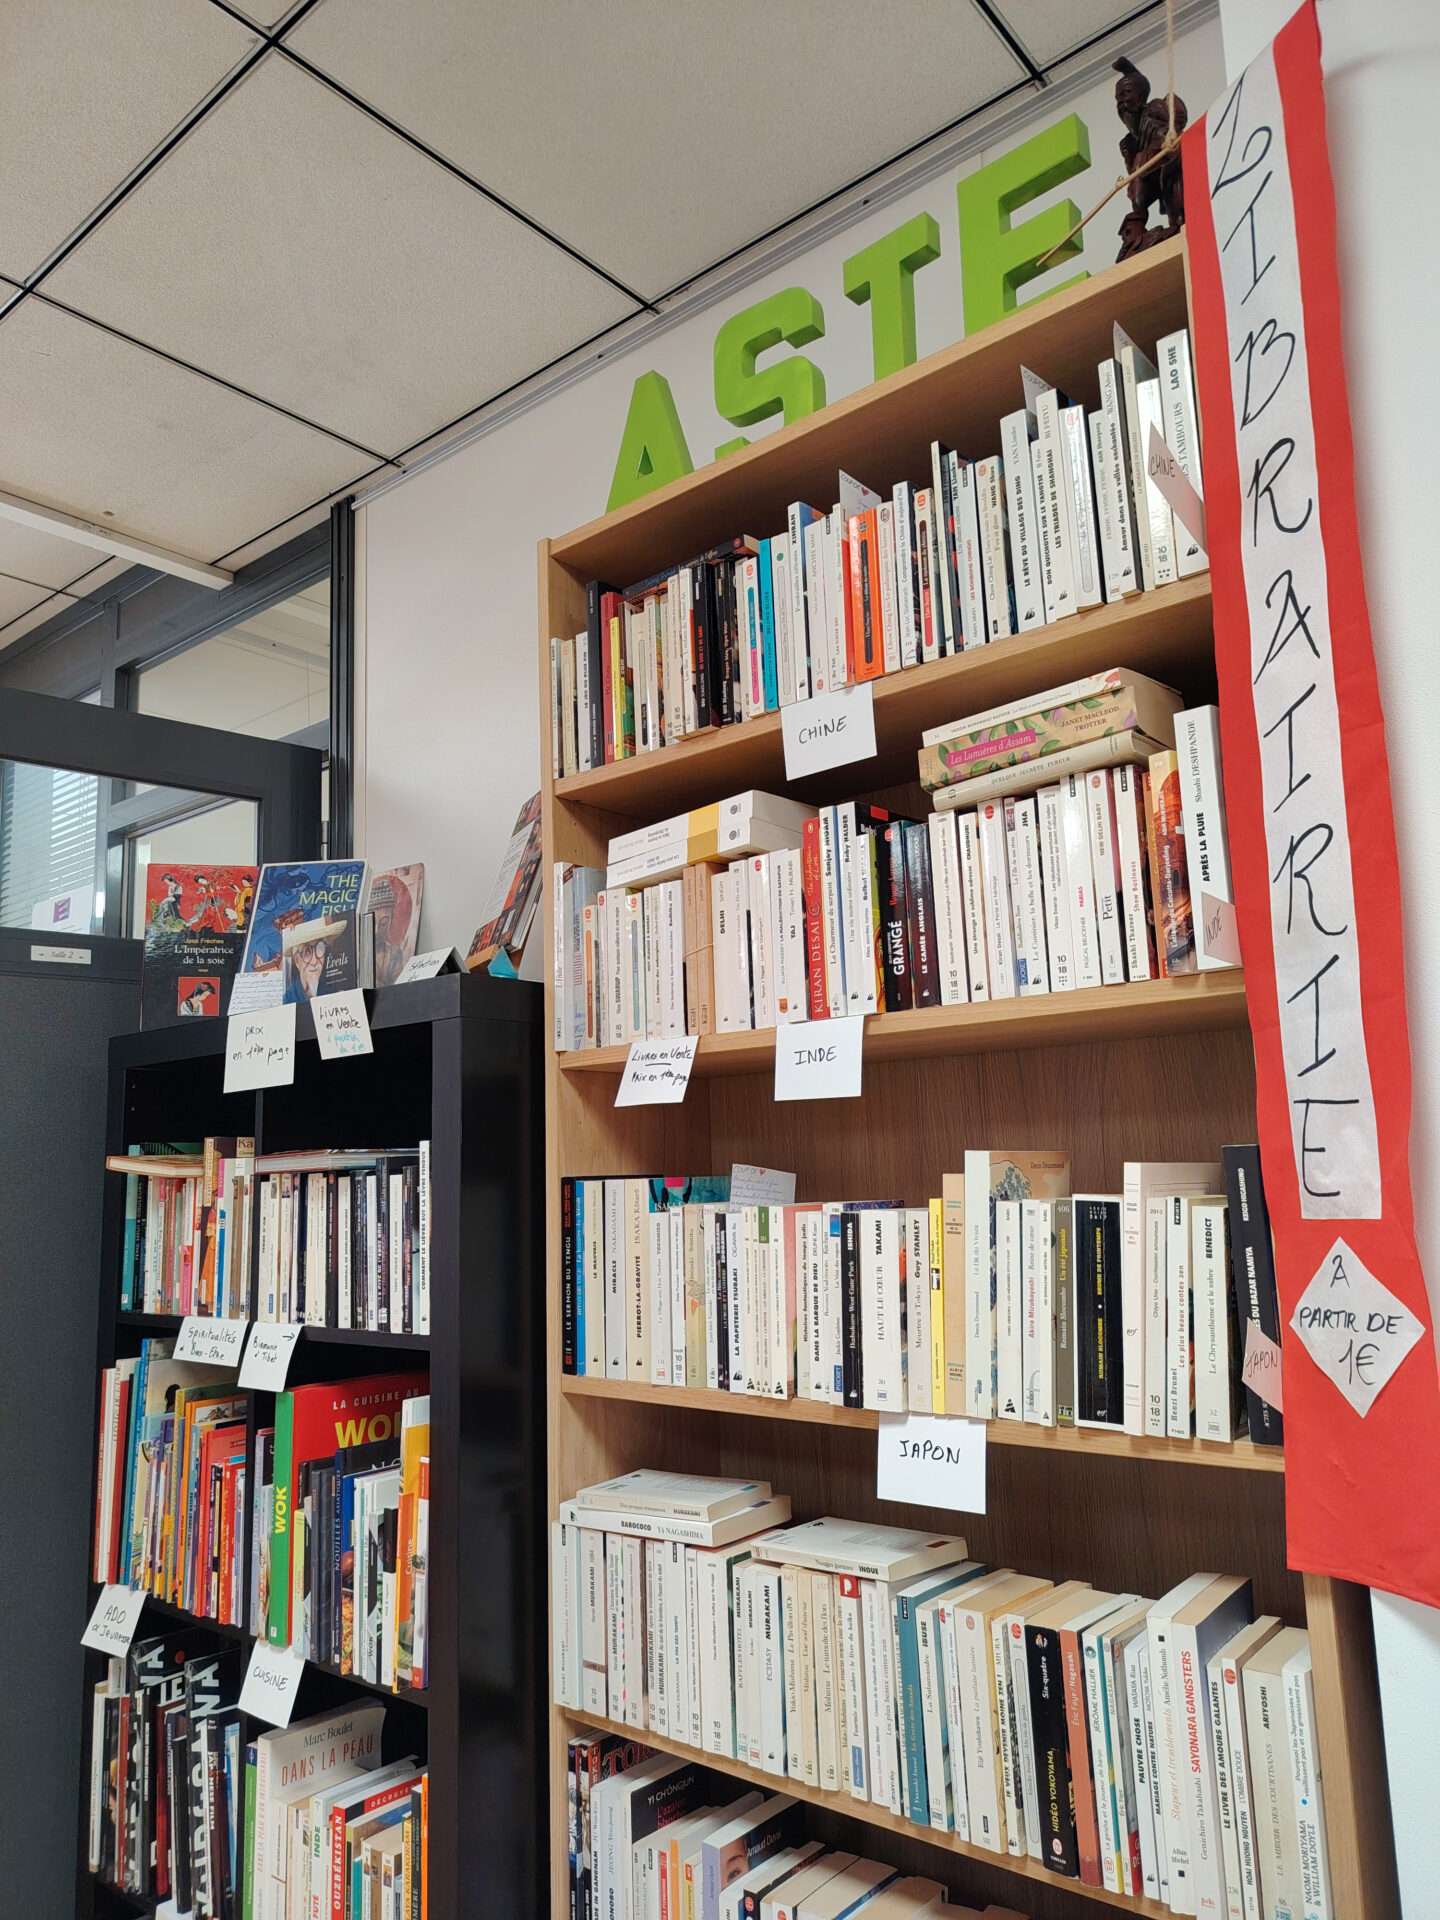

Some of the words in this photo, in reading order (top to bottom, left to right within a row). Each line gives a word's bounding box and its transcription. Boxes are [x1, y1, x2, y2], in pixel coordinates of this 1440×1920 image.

[604, 111, 1091, 514] ASTE
[1168, 346, 1177, 366] SHE
[1170, 369, 1180, 390] LAO
[1105, 389, 1113, 415] WANG
[1110, 423, 1120, 460] enchantée
[1173, 402, 1189, 463] TAMBOURS
[1046, 449, 1055, 488] SHANGHAI
[1113, 464, 1122, 487] vallée
[1014, 476, 1022, 494] DING
[1050, 491, 1057, 500] DE
[1116, 490, 1124, 503] une
[1018, 513, 1026, 541] VILLAGE
[1052, 503, 1060, 533] TRIADES
[1021, 545, 1027, 555] DU
[1043, 530, 1051, 567] QUICHOTTE
[1119, 527, 1128, 551] Amour
[1021, 558, 1029, 576] RÊVE
[1024, 578, 1030, 587] LE
[1210, 66, 1358, 1196] LIBRAIRIE
[798, 716, 848, 745] CHINE
[1074, 718, 1107, 732] TROTTER
[1186, 721, 1200, 777] DESHPANDE
[1196, 812, 1205, 837] PLUIE
[1198, 840, 1207, 851] LA
[328, 874, 360, 889] THE
[1199, 854, 1211, 882] APRÈS
[299, 889, 357, 905] MAGIC
[917, 898, 926, 933] ANGLAIS
[174, 944, 235, 956] L'Impératrice
[810, 920, 821, 961] DESAI
[888, 920, 905, 975] GRANGÉ
[919, 935, 927, 962] CAMÉE
[183, 956, 193, 965] de
[196, 956, 206, 965] la
[207, 957, 225, 965] soie
[921, 964, 927, 974] LE
[812, 967, 824, 1013] KIRAN
[794, 1046, 838, 1066] INDE
[421, 1199, 426, 1207] LA
[913, 1219, 921, 1257] STANLEY
[1204, 1218, 1213, 1259] BENEDICT
[565, 1268, 571, 1280] DU
[914, 1260, 922, 1279] Guy
[1245, 1247, 1256, 1278] NAMIYA
[813, 1283, 818, 1293] DE
[1248, 1279, 1258, 1305] BAZAR
[565, 1321, 571, 1330] LE
[1250, 1306, 1259, 1318] DU
[1299, 1306, 1359, 1333] PARTIR
[1366, 1312, 1404, 1334] DE
[814, 1329, 819, 1338] LA
[734, 1346, 740, 1356] LA
[1246, 1351, 1278, 1378] JAPON
[1338, 1338, 1380, 1385] 1€
[332, 1399, 346, 1411] LA
[353, 1391, 400, 1407] CUISINE
[1151, 1395, 1160, 1403] 10
[1151, 1407, 1160, 1416] 18
[898, 1440, 960, 1464] JAPON
[274, 1486, 287, 1534] WOK
[104, 1604, 127, 1624] ADO
[253, 1665, 289, 1691] CUISINE
[1040, 1656, 1050, 1699] Six-quatre
[1158, 1648, 1169, 1680] Nothomb
[1159, 1681, 1171, 1706] Amélie
[1181, 1650, 1196, 1714] GANGSTERS
[999, 1697, 1007, 1727] MOINE
[1211, 1681, 1221, 1726] GALANTES
[1260, 1686, 1270, 1729] ARIYOSHI
[304, 1731, 326, 1748] Marc
[1000, 1729, 1009, 1762] DEVENIR
[1134, 1717, 1142, 1746] CHOSE
[1147, 1721, 1155, 1749] NATURE
[1163, 1707, 1176, 1769] tremblements
[1186, 1715, 1201, 1774] SAYONARA
[281, 1754, 315, 1787] DANS
[321, 1747, 336, 1771] LA
[343, 1735, 373, 1763] PEAU
[1215, 1729, 1226, 1768] AMOURS
[1046, 1750, 1058, 1801] YOKOYAMA
[1136, 1749, 1146, 1784] PAUVRE
[1150, 1751, 1158, 1779] CONTRE
[1265, 1743, 1277, 1803] COURTISANES
[1218, 1771, 1227, 1788] DES
[1152, 1781, 1161, 1815] MARIAGE
[1169, 1783, 1181, 1821] Stupeur
[1193, 1777, 1204, 1817] Takahashi
[1221, 1791, 1230, 1816] LIVRE
[1049, 1802, 1060, 1832] HIDÉO
[1223, 1818, 1231, 1829] LE
[1240, 1810, 1249, 1840] NGUYEN
[1242, 1841, 1252, 1867] HUONG
[1273, 1828, 1282, 1859] MIROIR
[1299, 1820, 1309, 1870] MORIYAMA
[1307, 1824, 1317, 1857] DOYLE
[333, 1815, 342, 1910] OUZBÉKISTAN
[1277, 1864, 1284, 1876] LE
[1304, 1872, 1312, 1904] NAOMI
[1310, 1859, 1320, 1897] WILLIAM
